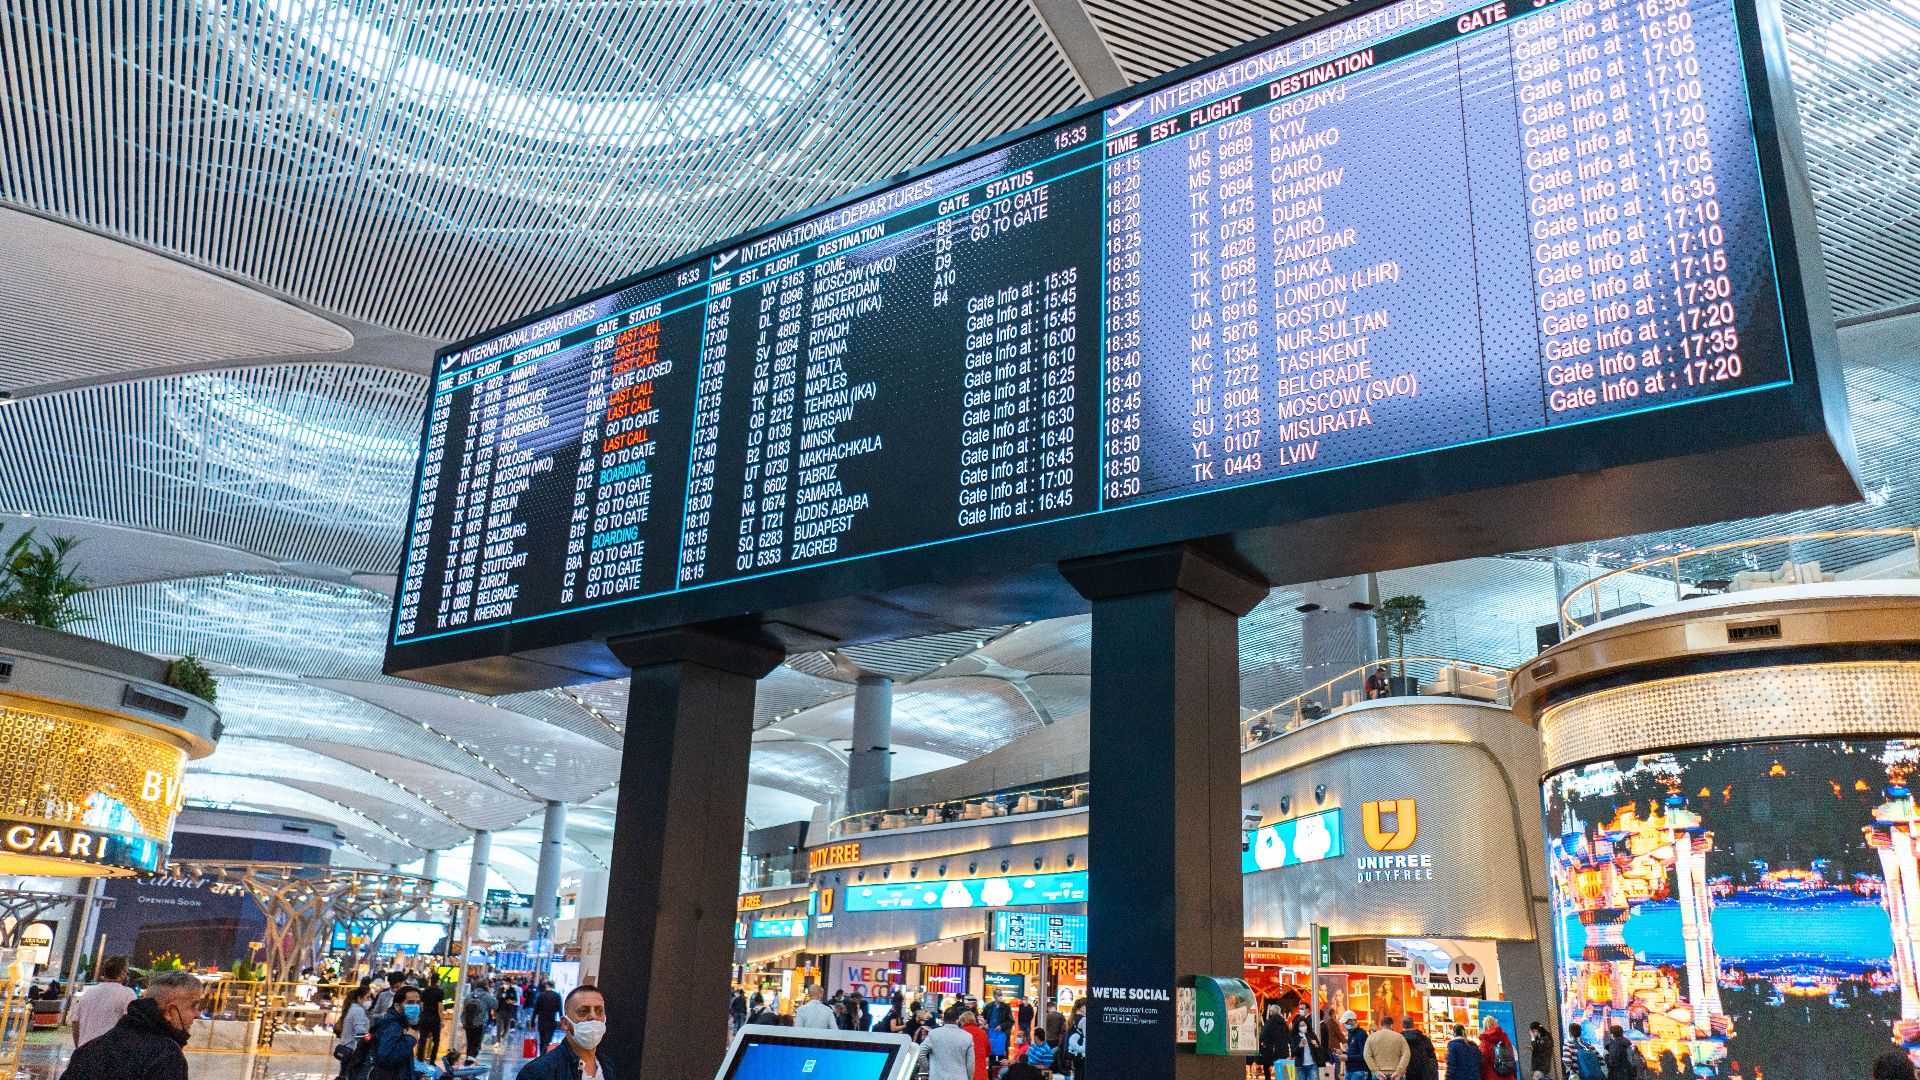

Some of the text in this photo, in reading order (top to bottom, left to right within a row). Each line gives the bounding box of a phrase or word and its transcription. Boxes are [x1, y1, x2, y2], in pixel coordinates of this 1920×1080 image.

[1150, 0, 1443, 117] INTERNATIONAL DEPARTURES
[1106, 1, 1506, 158] TIME EST. FLIGHT DESTINATION GATE
[1269, 83, 1346, 125] GROZNYJ
[1054, 125, 1086, 150] 15:33
[1270, 117, 1306, 145] KYIV
[1270, 126, 1338, 165] BAMAKO
[1271, 152, 1322, 185] CAIRO
[1271, 166, 1344, 205] KHARKIV
[971, 185, 1048, 224] GO TO GATE
[1272, 194, 1323, 226] DUBAI
[710, 170, 1033, 295] TIME EST. FLIGHT DESTINATION GATE STATUS
[741, 181, 932, 263] INTERNATIONAL DEPARTURES
[937, 219, 951, 236] B3
[1273, 215, 1325, 246] CAIRO
[936, 236, 952, 254] D5
[1273, 228, 1355, 267] ZANZIBAR
[813, 254, 897, 294] MOSCOW (VKO)
[814, 255, 846, 278] ROME
[935, 254, 951, 272] D9
[1274, 256, 1331, 288] DHAKA
[676, 268, 700, 288] 15:33
[934, 270, 956, 289] A10
[1275, 258, 1399, 310] LONDON (LHR)
[1539, 250, 1727, 313] Gate Info at 17:15
[812, 277, 879, 311] AMSTERDAM
[933, 290, 948, 307] B4
[810, 292, 882, 328] TEHRAN (IKA)
[1275, 296, 1347, 332] ROSTOV
[1542, 275, 1731, 338] Gate Info at 17:30
[460, 306, 595, 365] INTERNATIONAL DEPARTURES
[809, 320, 849, 344] RIYADH
[1276, 308, 1388, 354] NUR-SULTAN
[438, 303, 661, 391] TIME EST. FLIGHT DESTINATION GATE STATUS
[808, 338, 848, 362] VIENNA
[1277, 336, 1369, 376] TASHKENT
[509, 364, 537, 383] AMMAN
[611, 360, 672, 390] GATE CLOSED
[806, 356, 842, 379] MALTA
[1277, 359, 1371, 398] BELGRADE
[507, 381, 528, 397] BAKU
[805, 372, 847, 396] NAPLES
[1278, 370, 1417, 420] MOSCOW (SVO)
[1549, 354, 1742, 413] Gate Info at 17:20
[505, 388, 548, 411] HANNOVER
[804, 380, 877, 414] TEHRAN (IKA)
[503, 403, 543, 425] BRUSSELS
[802, 406, 853, 431] WARSAW
[1279, 406, 1371, 443] MISURATA
[501, 415, 550, 440] NUREMBERG
[800, 428, 835, 449] MINSK
[498, 439, 518, 454] RIGA
[603, 429, 648, 452] LAST CALL
[799, 434, 882, 467] MAKHACHKALA
[496, 448, 534, 469] COLOGNE
[1279, 441, 1317, 466] LVIV
[494, 456, 554, 484] MOSCOW (VKO)
[599, 461, 645, 484] BOARDING
[798, 463, 837, 485] TABRIZ
[1193, 452, 1261, 483] TK 0443
[492, 478, 530, 498] BOLOGNA
[796, 480, 842, 503] SAMARA
[1103, 476, 1139, 500] 18:50
[490, 496, 518, 513] BERLIN
[795, 493, 869, 522] ADDIS ABABA
[488, 512, 512, 528] MILAN
[793, 515, 854, 540] BUDAPEST
[485, 523, 527, 544] SALZBURG
[591, 527, 638, 548] BOARDING
[483, 542, 513, 559] VILNIUS
[736, 548, 781, 570] OU 5353
[791, 537, 837, 559] ZAGREB
[481, 553, 527, 574] STUTTGART
[680, 564, 704, 581] 18:15
[478, 573, 508, 590] ZURICH
[585, 576, 640, 598] GO TO GATE
[476, 586, 519, 605] BELGRADE
[436, 611, 468, 628] TK 0473
[473, 602, 512, 621] KHERSON
[398, 622, 415, 635] 16:35
[0, 826, 108, 858] GARI
[830, 844, 860, 864] FREE
[1358, 854, 1432, 870] UNIFREE
[1358, 868, 1432, 883] DUTYFREE
[1010, 958, 1082, 976] DUT FREE
[1454, 976, 1478, 984] SALE
[1092, 986, 1170, 1000] WE'RE SOCIAL
